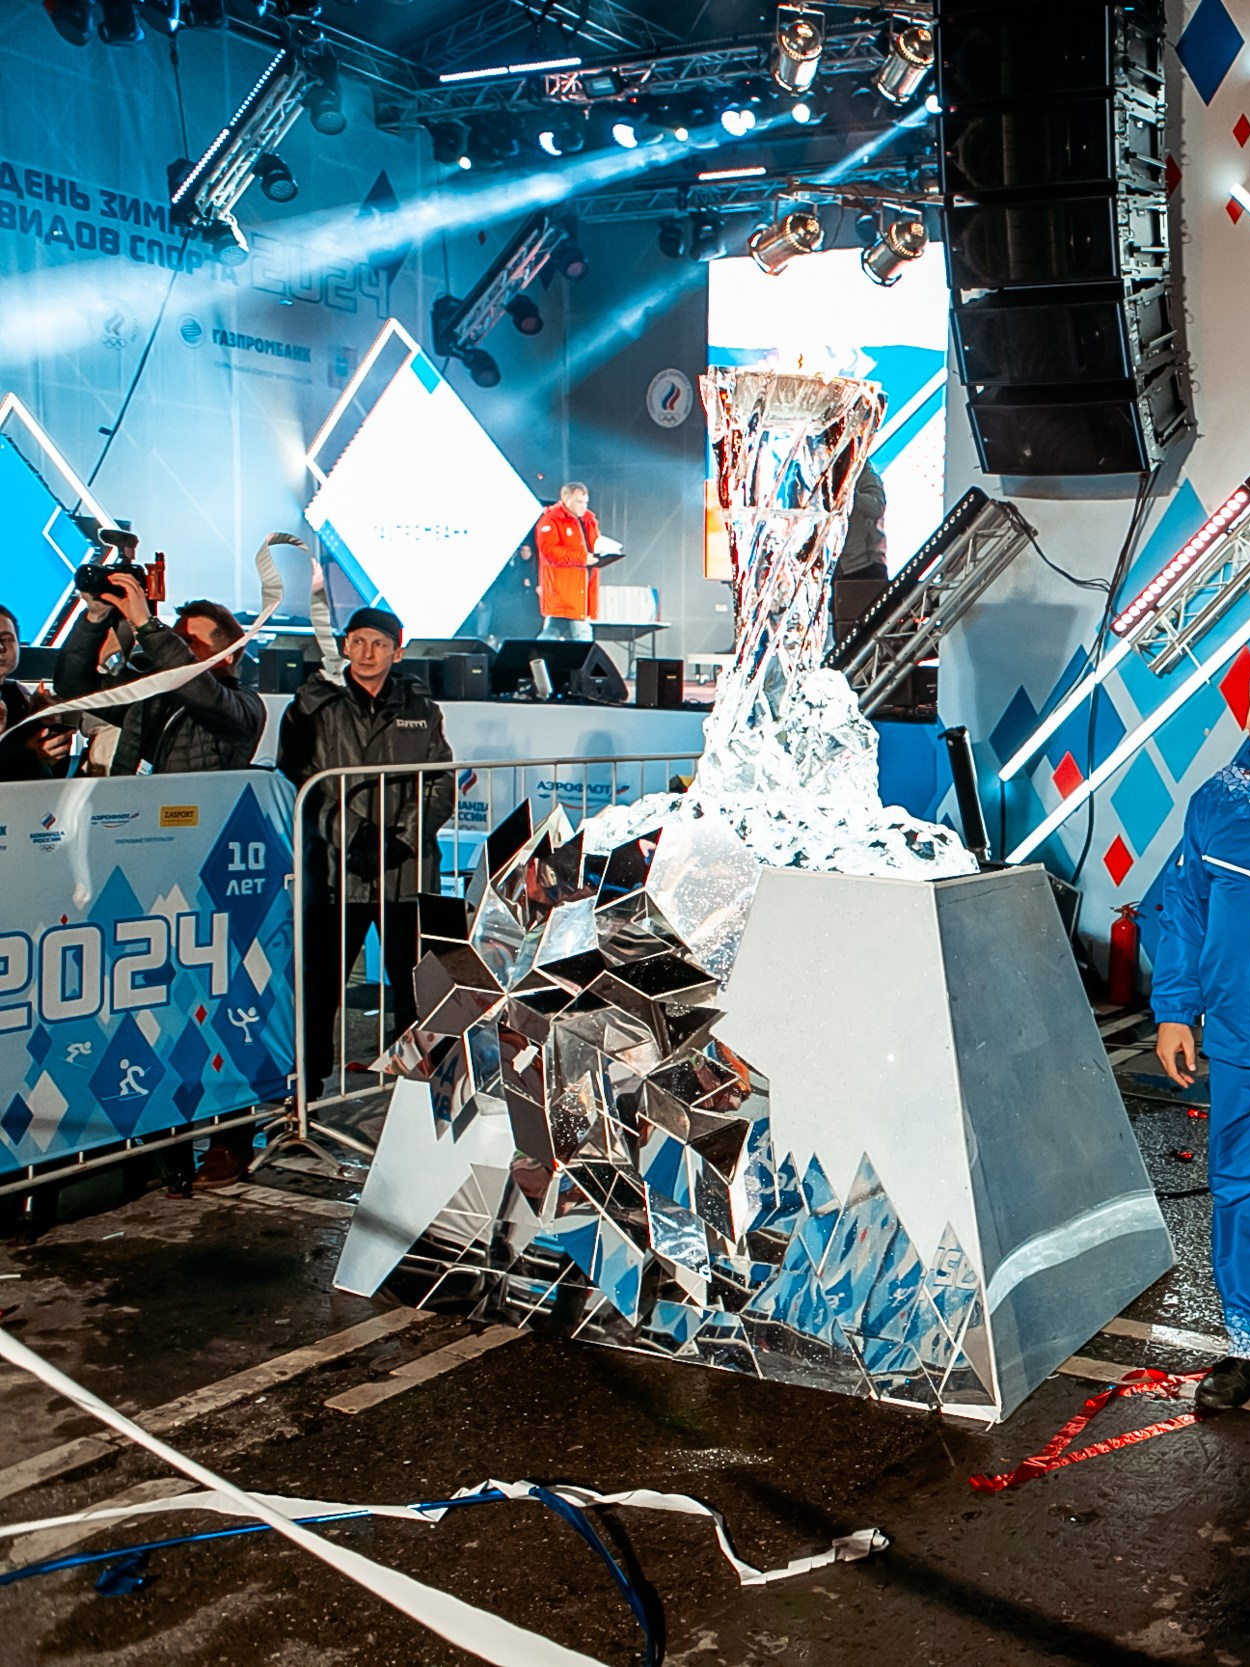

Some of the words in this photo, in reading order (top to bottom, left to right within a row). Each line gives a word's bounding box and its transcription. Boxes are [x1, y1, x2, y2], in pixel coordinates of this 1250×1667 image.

[0, 161, 90, 212] ДЕНЬ
[99, 189, 200, 240] ЗИМН
[0, 202, 120, 256] ВИДОВ
[251, 232, 390, 320] 2024
[212, 328, 312, 363] ГАЗПРОМБАНК
[164, 811, 194, 819] ZASPORT
[228, 841, 266, 871] 10
[0, 911, 229, 1035] 2024
